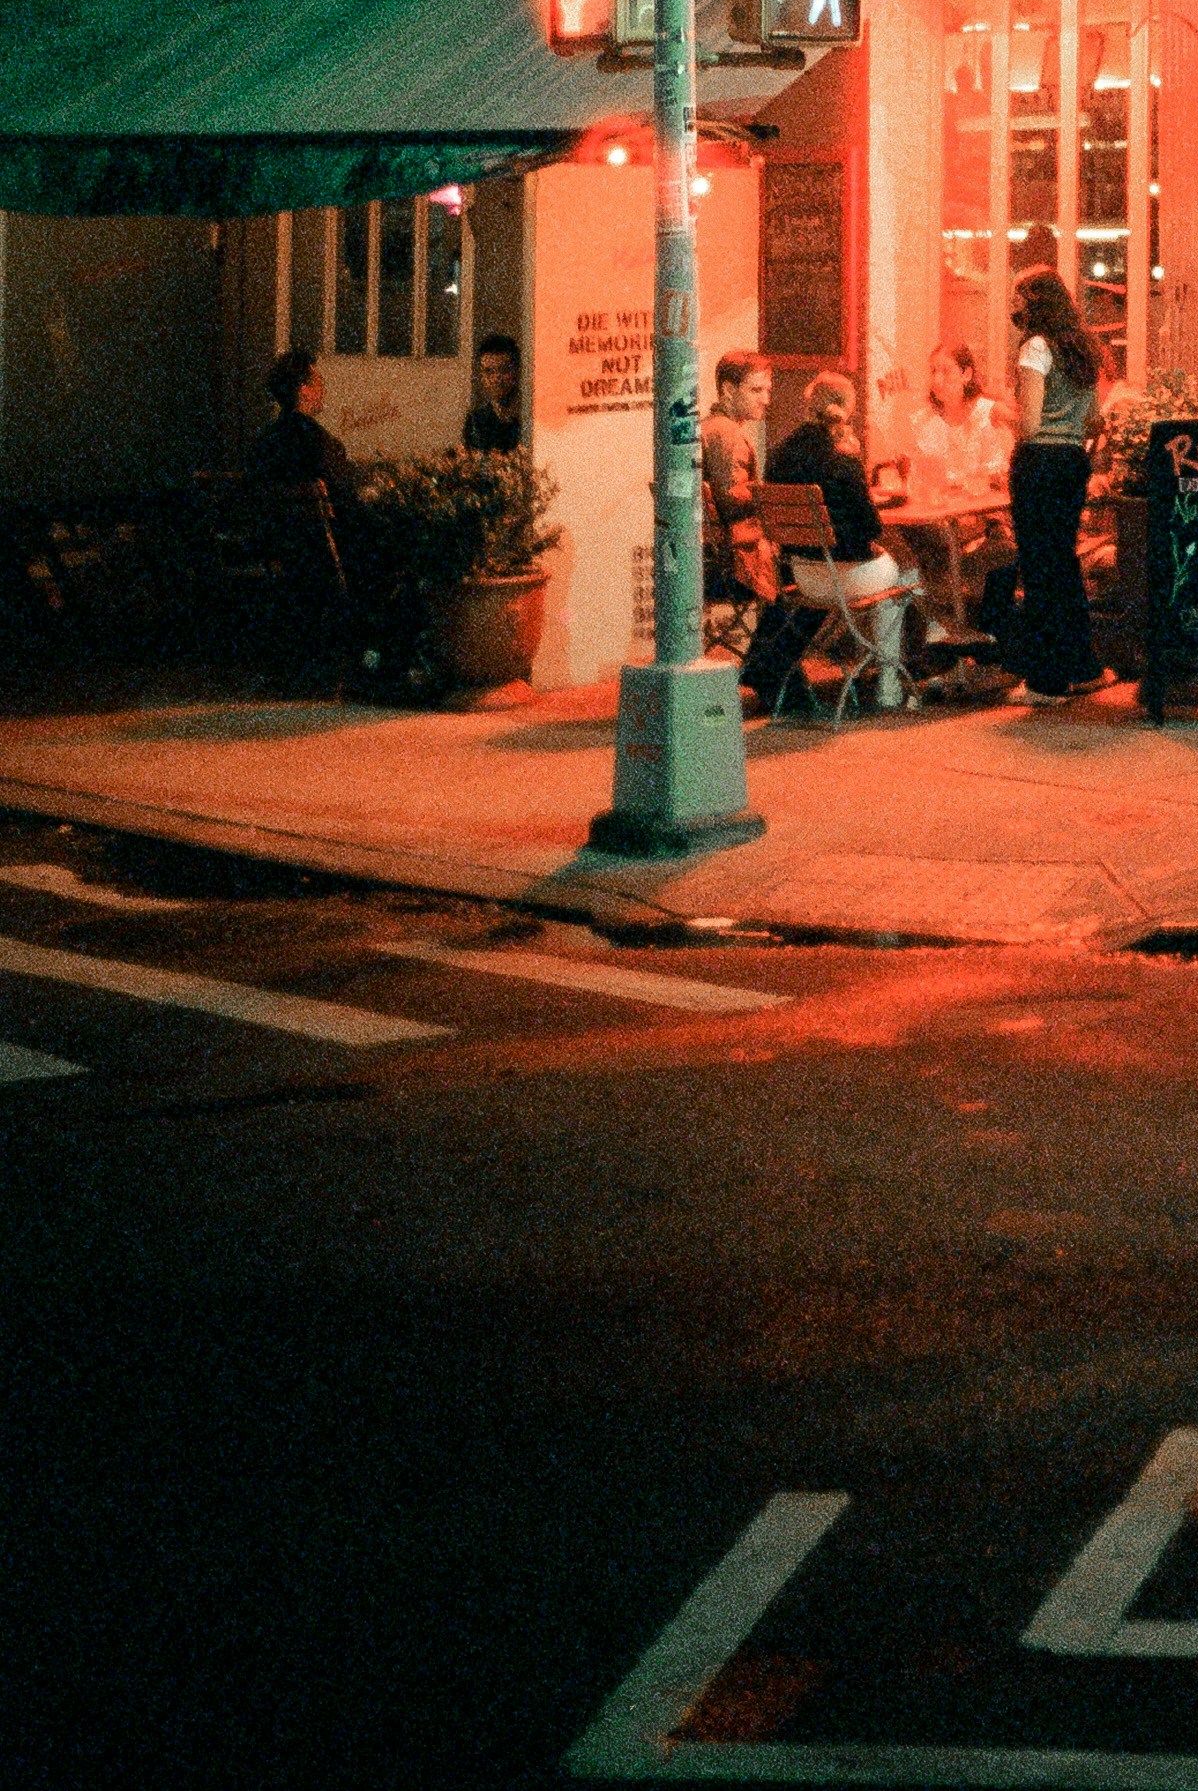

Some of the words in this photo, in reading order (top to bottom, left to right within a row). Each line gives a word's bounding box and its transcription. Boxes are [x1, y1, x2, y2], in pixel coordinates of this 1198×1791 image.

[577, 312, 608, 331] DIE
[616, 311, 652, 328] WIT
[569, 334, 654, 354] MEMORI
[602, 355, 641, 374] NOT
[580, 376, 653, 398] DREAM
